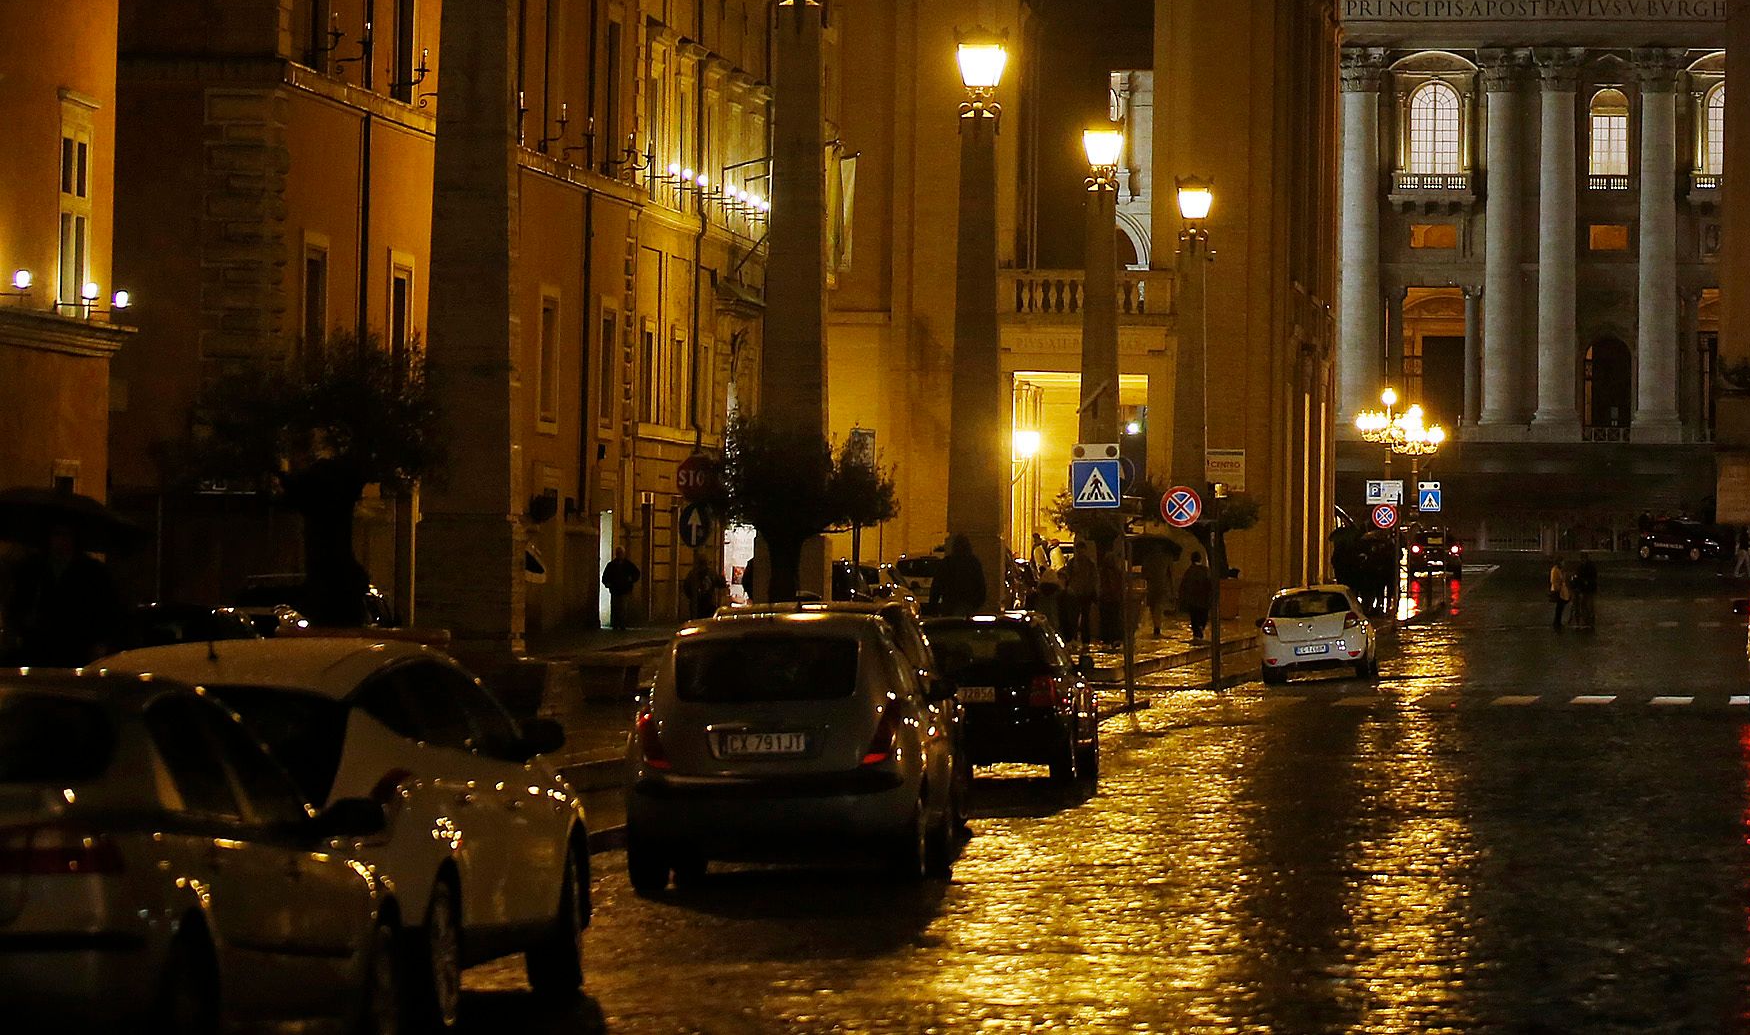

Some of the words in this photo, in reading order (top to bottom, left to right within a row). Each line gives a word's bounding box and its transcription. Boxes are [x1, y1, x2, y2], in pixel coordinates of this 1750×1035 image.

[1346, 0, 1465, 16] PRINCIPIS
[1469, 0, 1541, 16] APOST
[1545, 0, 1622, 16] PAVLVS
